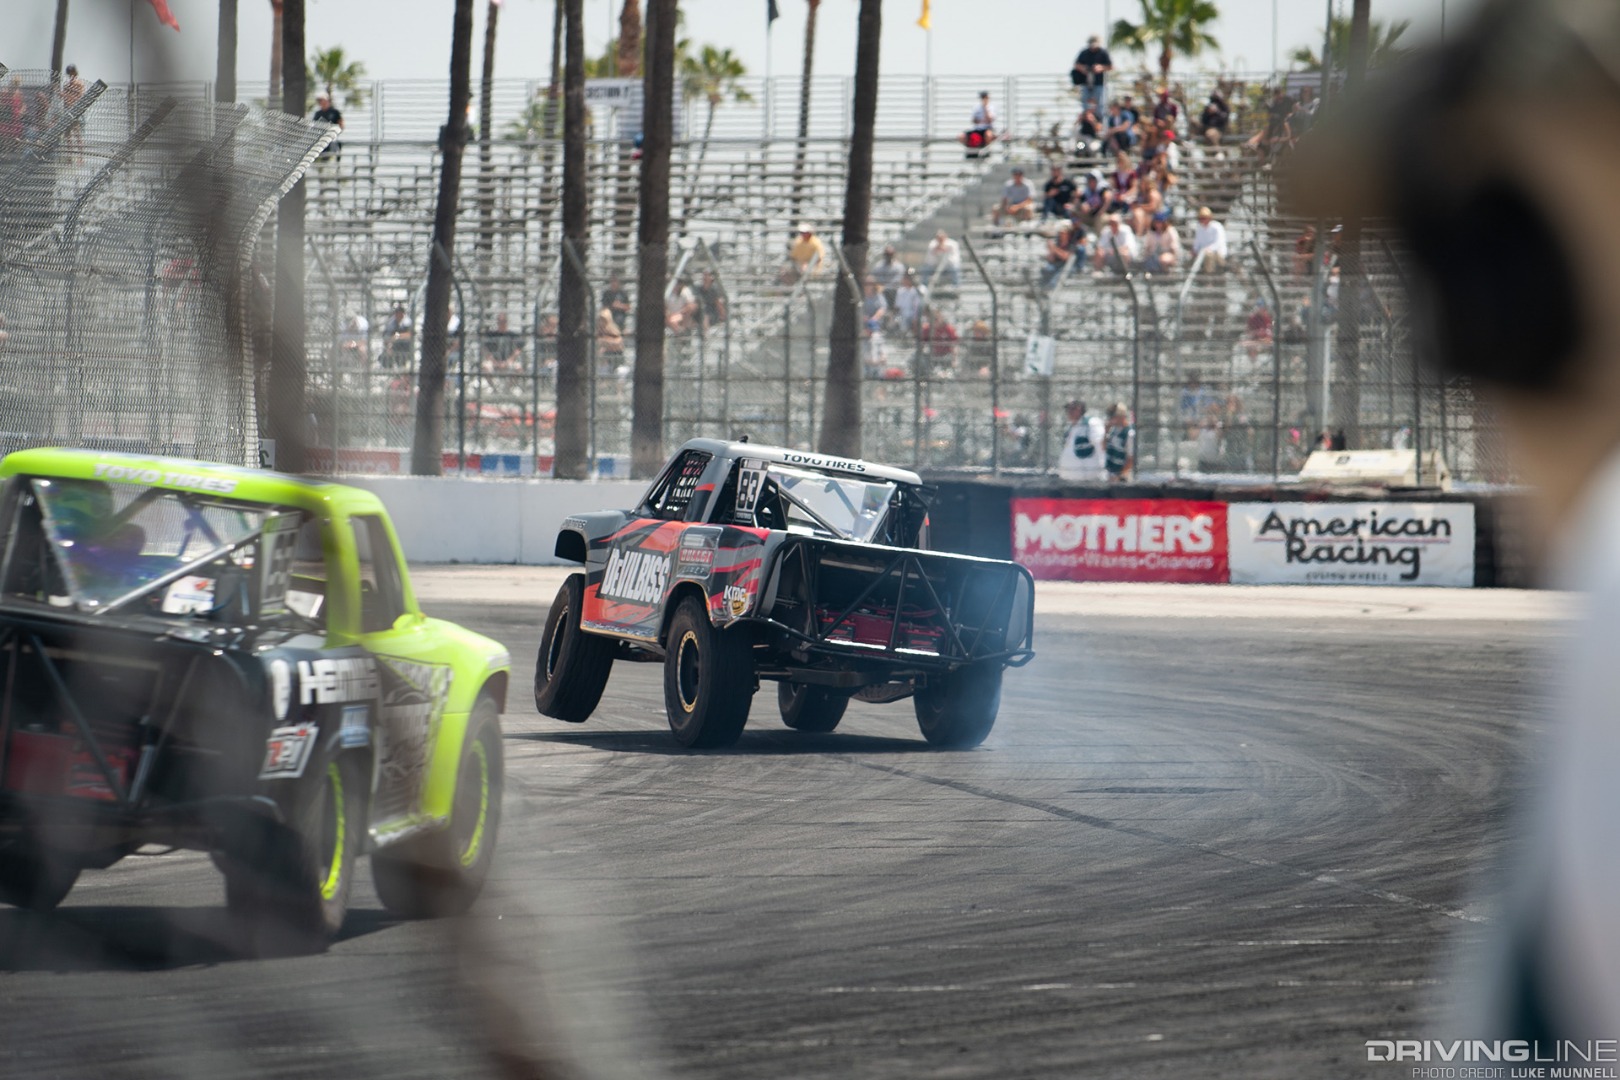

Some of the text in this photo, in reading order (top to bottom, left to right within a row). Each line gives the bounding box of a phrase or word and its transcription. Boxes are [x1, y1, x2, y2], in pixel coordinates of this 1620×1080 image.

[94, 463, 239, 494] TOYO TIRES
[825, 459, 866, 472] TIRES
[738, 470, 760, 510] 83
[1014, 512, 1214, 552] MOTHERS
[1259, 509, 1451, 537] American
[1285, 533, 1421, 580] Racing
